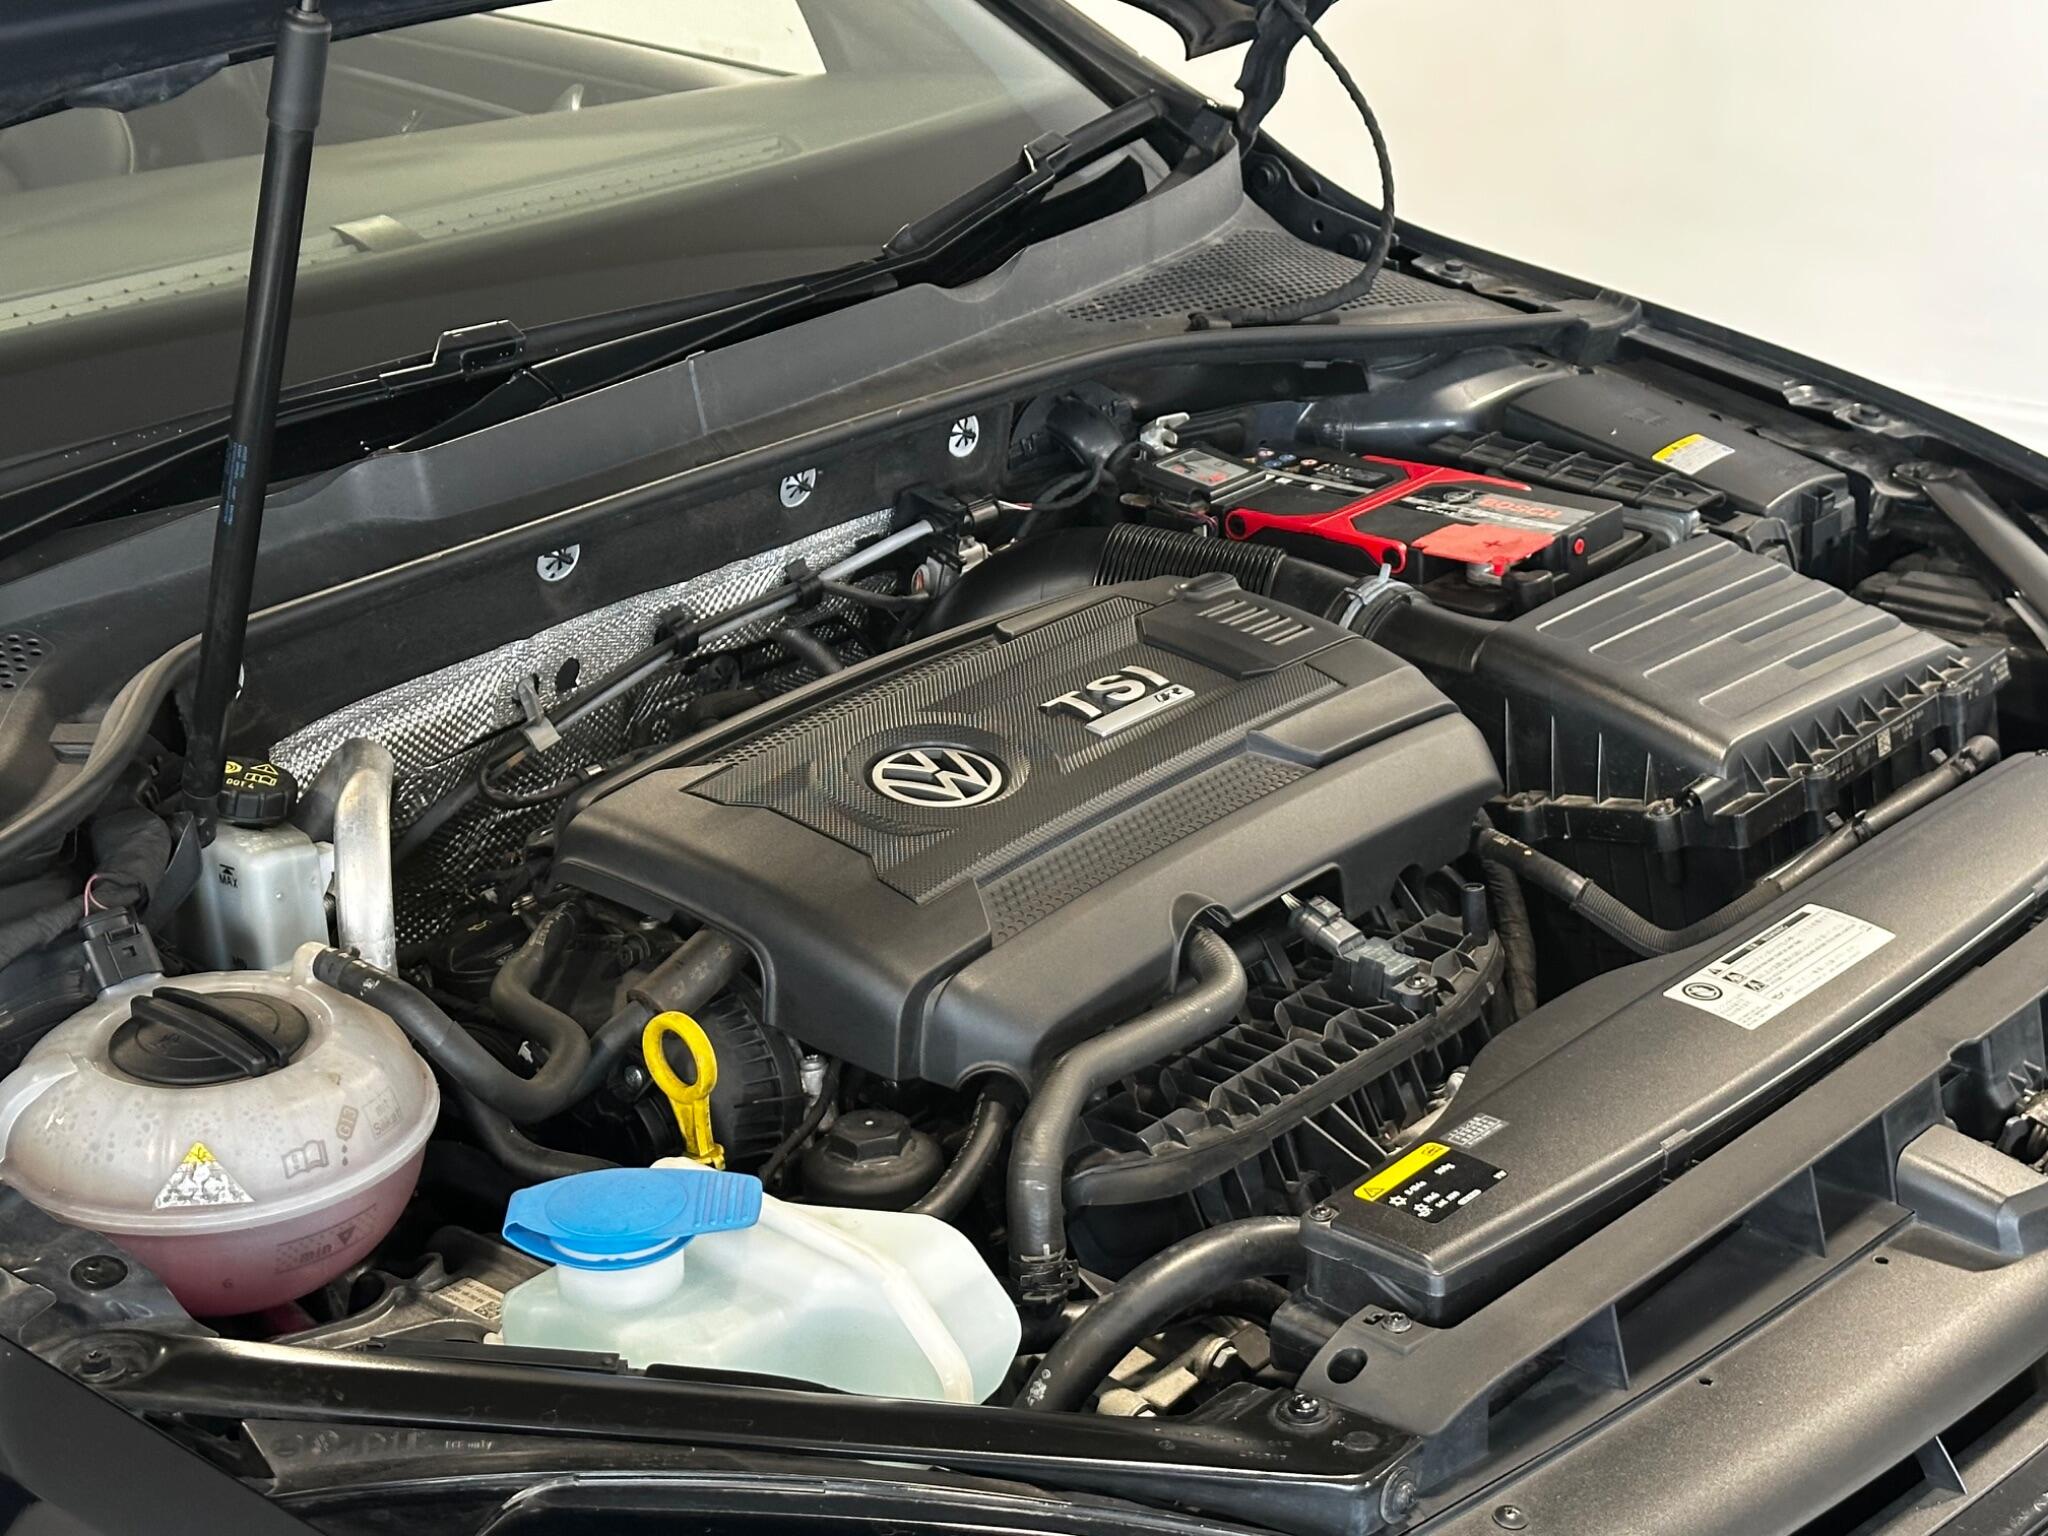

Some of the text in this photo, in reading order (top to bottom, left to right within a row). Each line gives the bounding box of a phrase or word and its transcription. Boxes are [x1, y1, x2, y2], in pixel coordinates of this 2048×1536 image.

[1477, 496, 1563, 519] BOSCH
[1038, 665, 1170, 718] TSI
[226, 777, 255, 789] DOT 4
[219, 874, 238, 888] MAX
[299, 1242, 333, 1263] min
